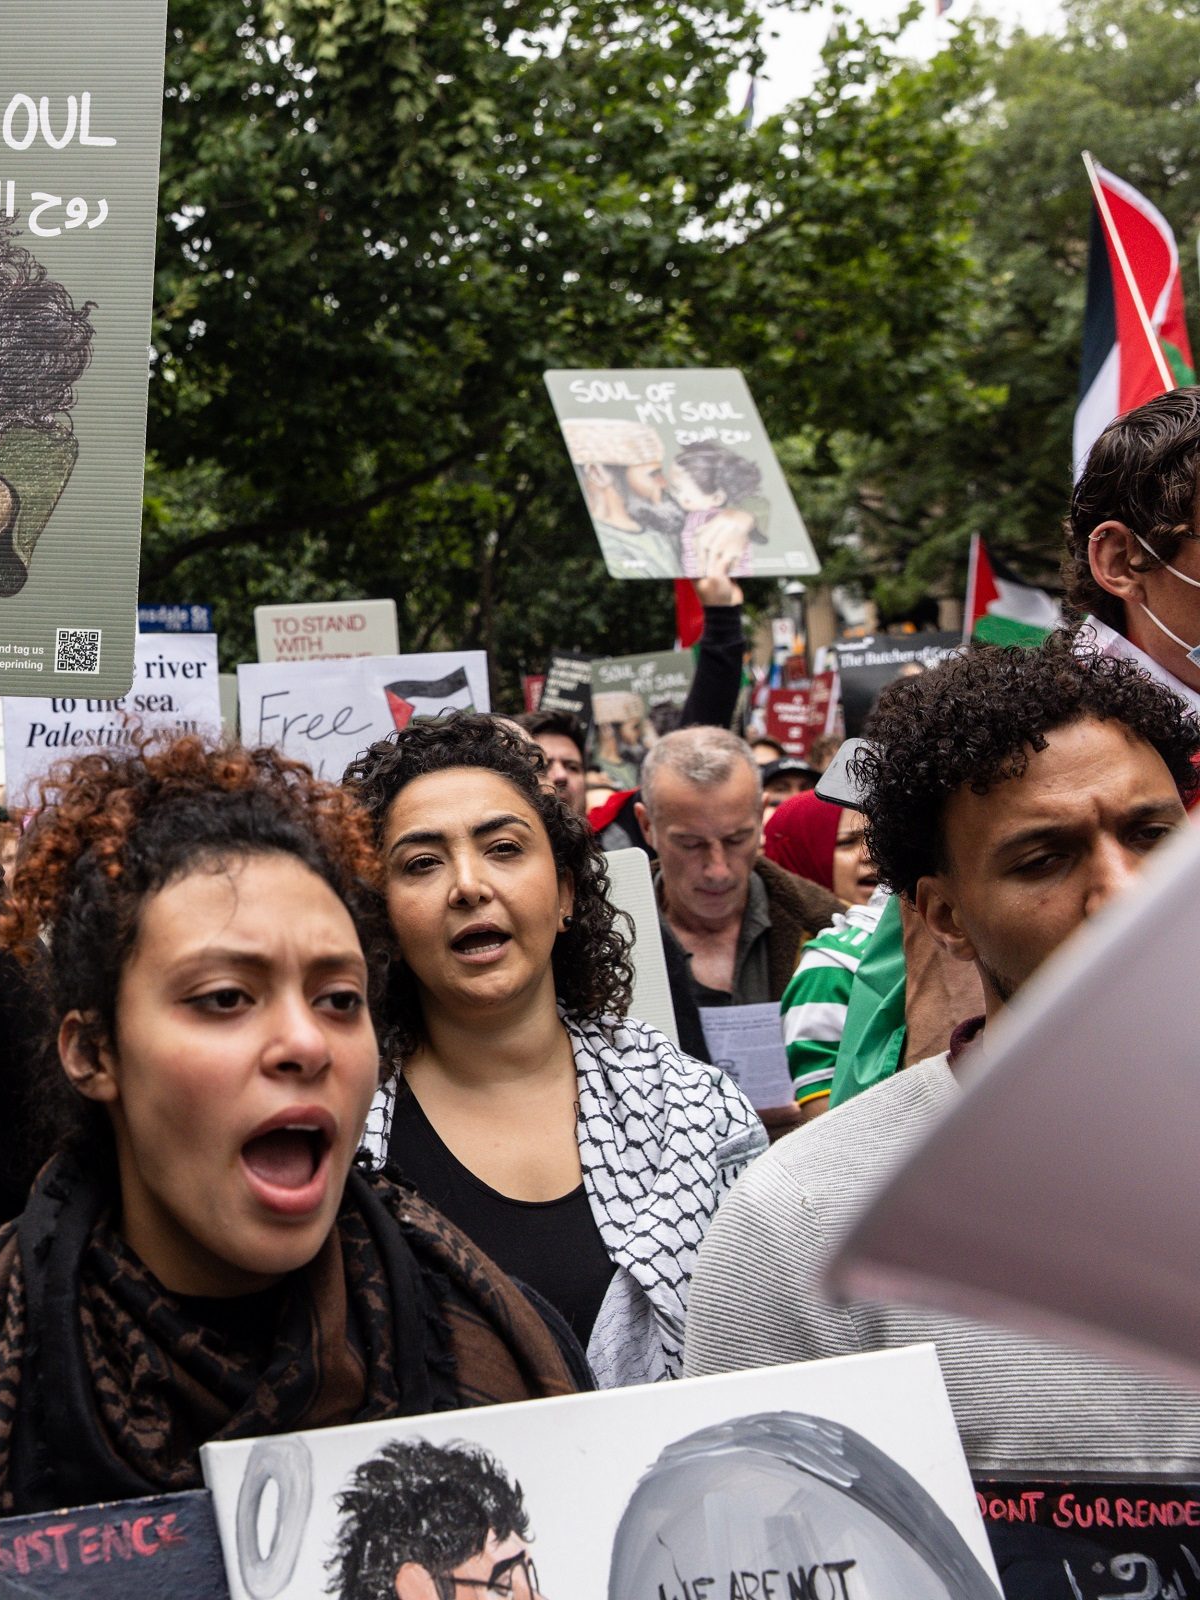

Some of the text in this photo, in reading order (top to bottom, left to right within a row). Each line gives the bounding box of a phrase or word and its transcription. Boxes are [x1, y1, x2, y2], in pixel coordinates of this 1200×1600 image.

[28, 190, 109, 237] روح
[569, 379, 677, 403] SOUL OF
[635, 401, 745, 425] MY SOUL
[138, 605, 189, 623] nsdale
[272, 614, 367, 635] TO STAND
[14, 645, 30, 656] tag
[32, 647, 44, 655] us
[274, 636, 323, 653] WITH
[145, 655, 207, 679] river
[599, 664, 635, 683] SOUL
[52, 697, 76, 713] to
[134, 693, 180, 713] sea.
[259, 691, 373, 747] Free
[976, 1492, 1200, 1528] DONT SURRENDE
[730, 1570, 780, 1600] ARE
[787, 1559, 856, 1600] NOT
